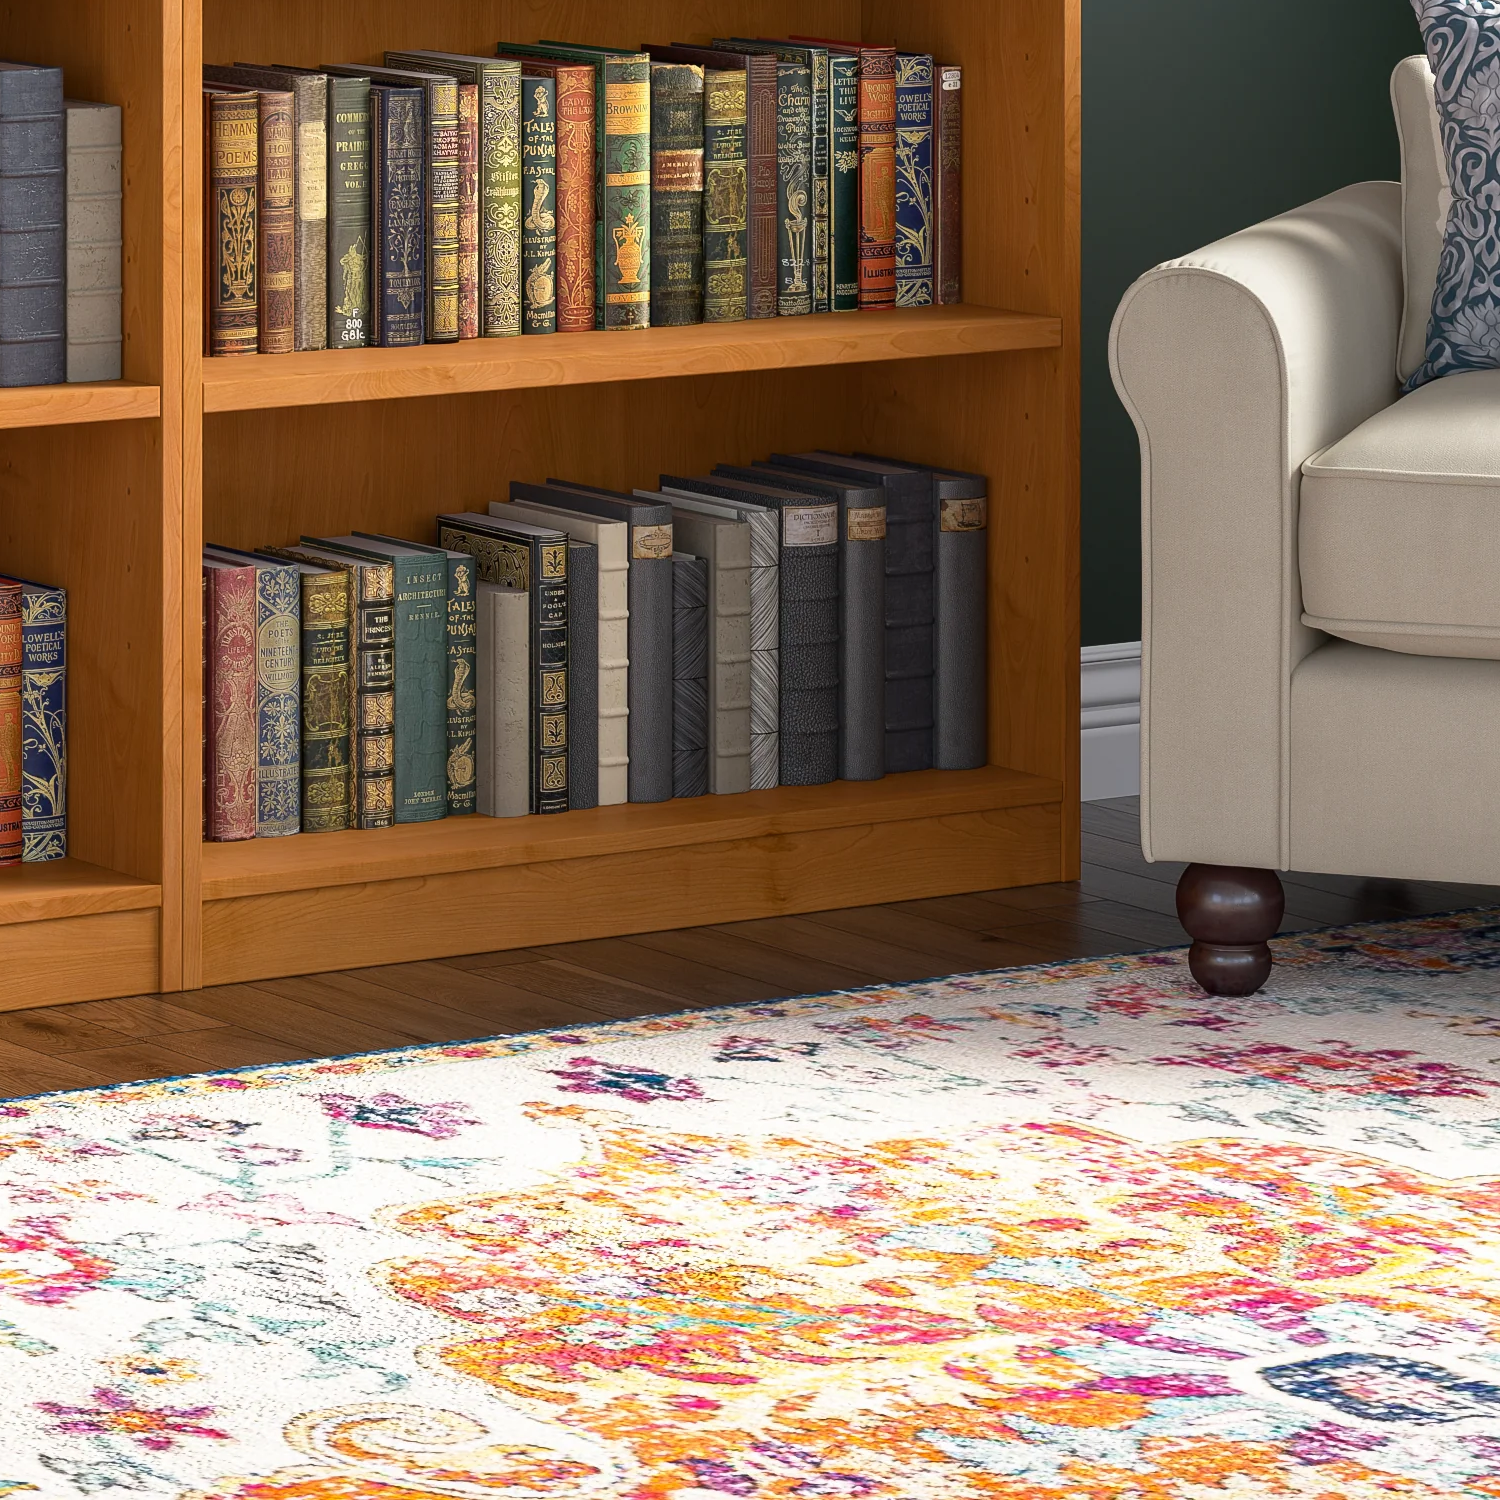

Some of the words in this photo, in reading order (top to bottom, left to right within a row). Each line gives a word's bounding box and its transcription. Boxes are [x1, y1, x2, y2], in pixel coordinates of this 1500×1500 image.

[839, 87, 857, 95] THAT
[863, 82, 891, 93] AROUND
[561, 97, 584, 107] LADY
[778, 93, 811, 107] Charm
[839, 97, 857, 105] LIVE
[561, 106, 578, 116] THE
[898, 102, 929, 112] POETICAL
[900, 112, 927, 123] WORKS
[213, 120, 258, 138] HEMANS
[523, 119, 555, 134] TALES
[268, 143, 291, 154] HOW
[273, 157, 290, 166] AND
[270, 167, 292, 180] LADY
[267, 184, 292, 195] WHY
[352, 308, 359, 318] F
[345, 318, 362, 329] 800
[405, 572, 442, 585] INSECT
[544, 589, 565, 597] UNDER
[447, 598, 476, 613] TALES
[275, 620, 289, 628] THE
[373, 615, 389, 624] THE
[268, 628, 294, 638] POETS
[25, 641, 62, 653] POETICAL
[28, 651, 58, 664] WORKS
[265, 656, 296, 669] CENTURY
